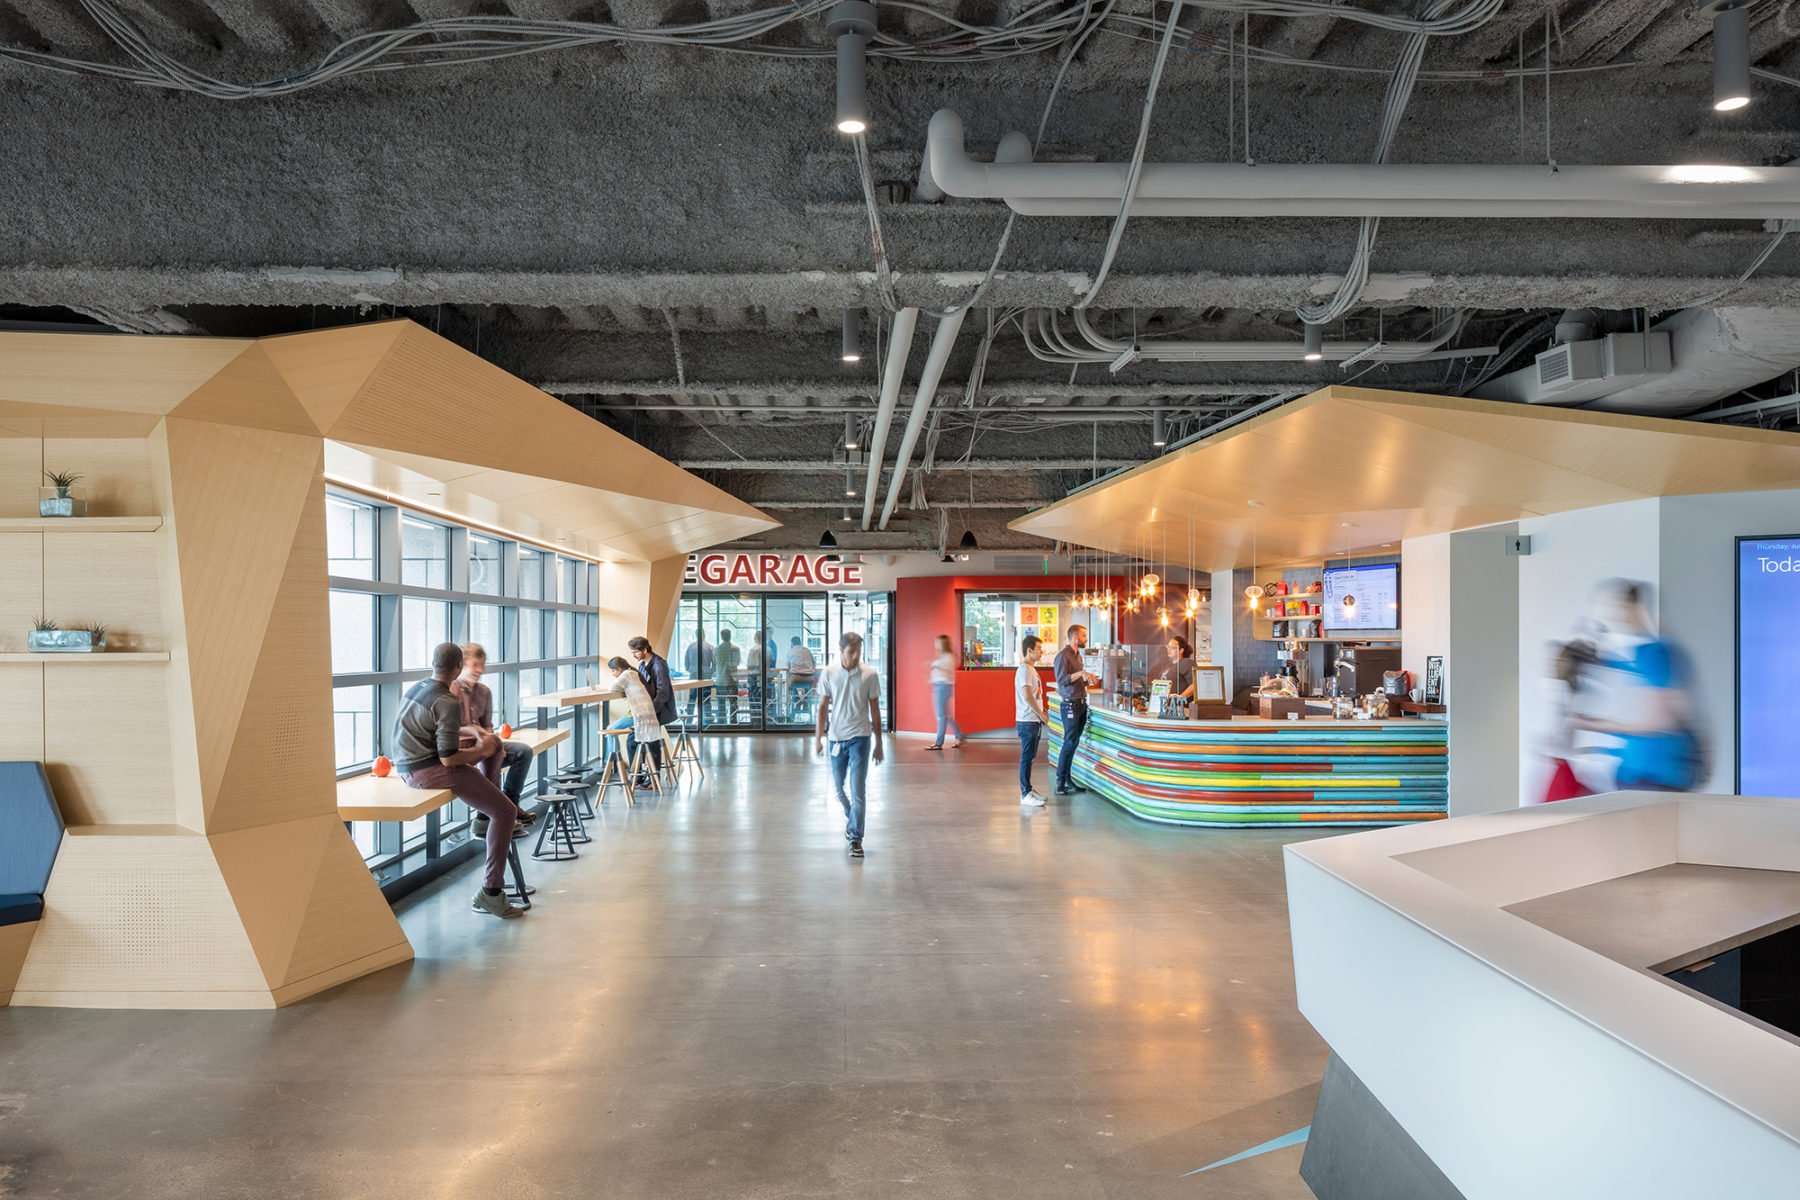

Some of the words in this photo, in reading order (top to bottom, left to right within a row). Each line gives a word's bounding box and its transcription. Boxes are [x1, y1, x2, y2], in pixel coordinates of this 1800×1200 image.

[699, 554, 862, 586] GARAGE
[1757, 556, 1800, 573] Toda
[1159, 696, 1188, 718] EAT
